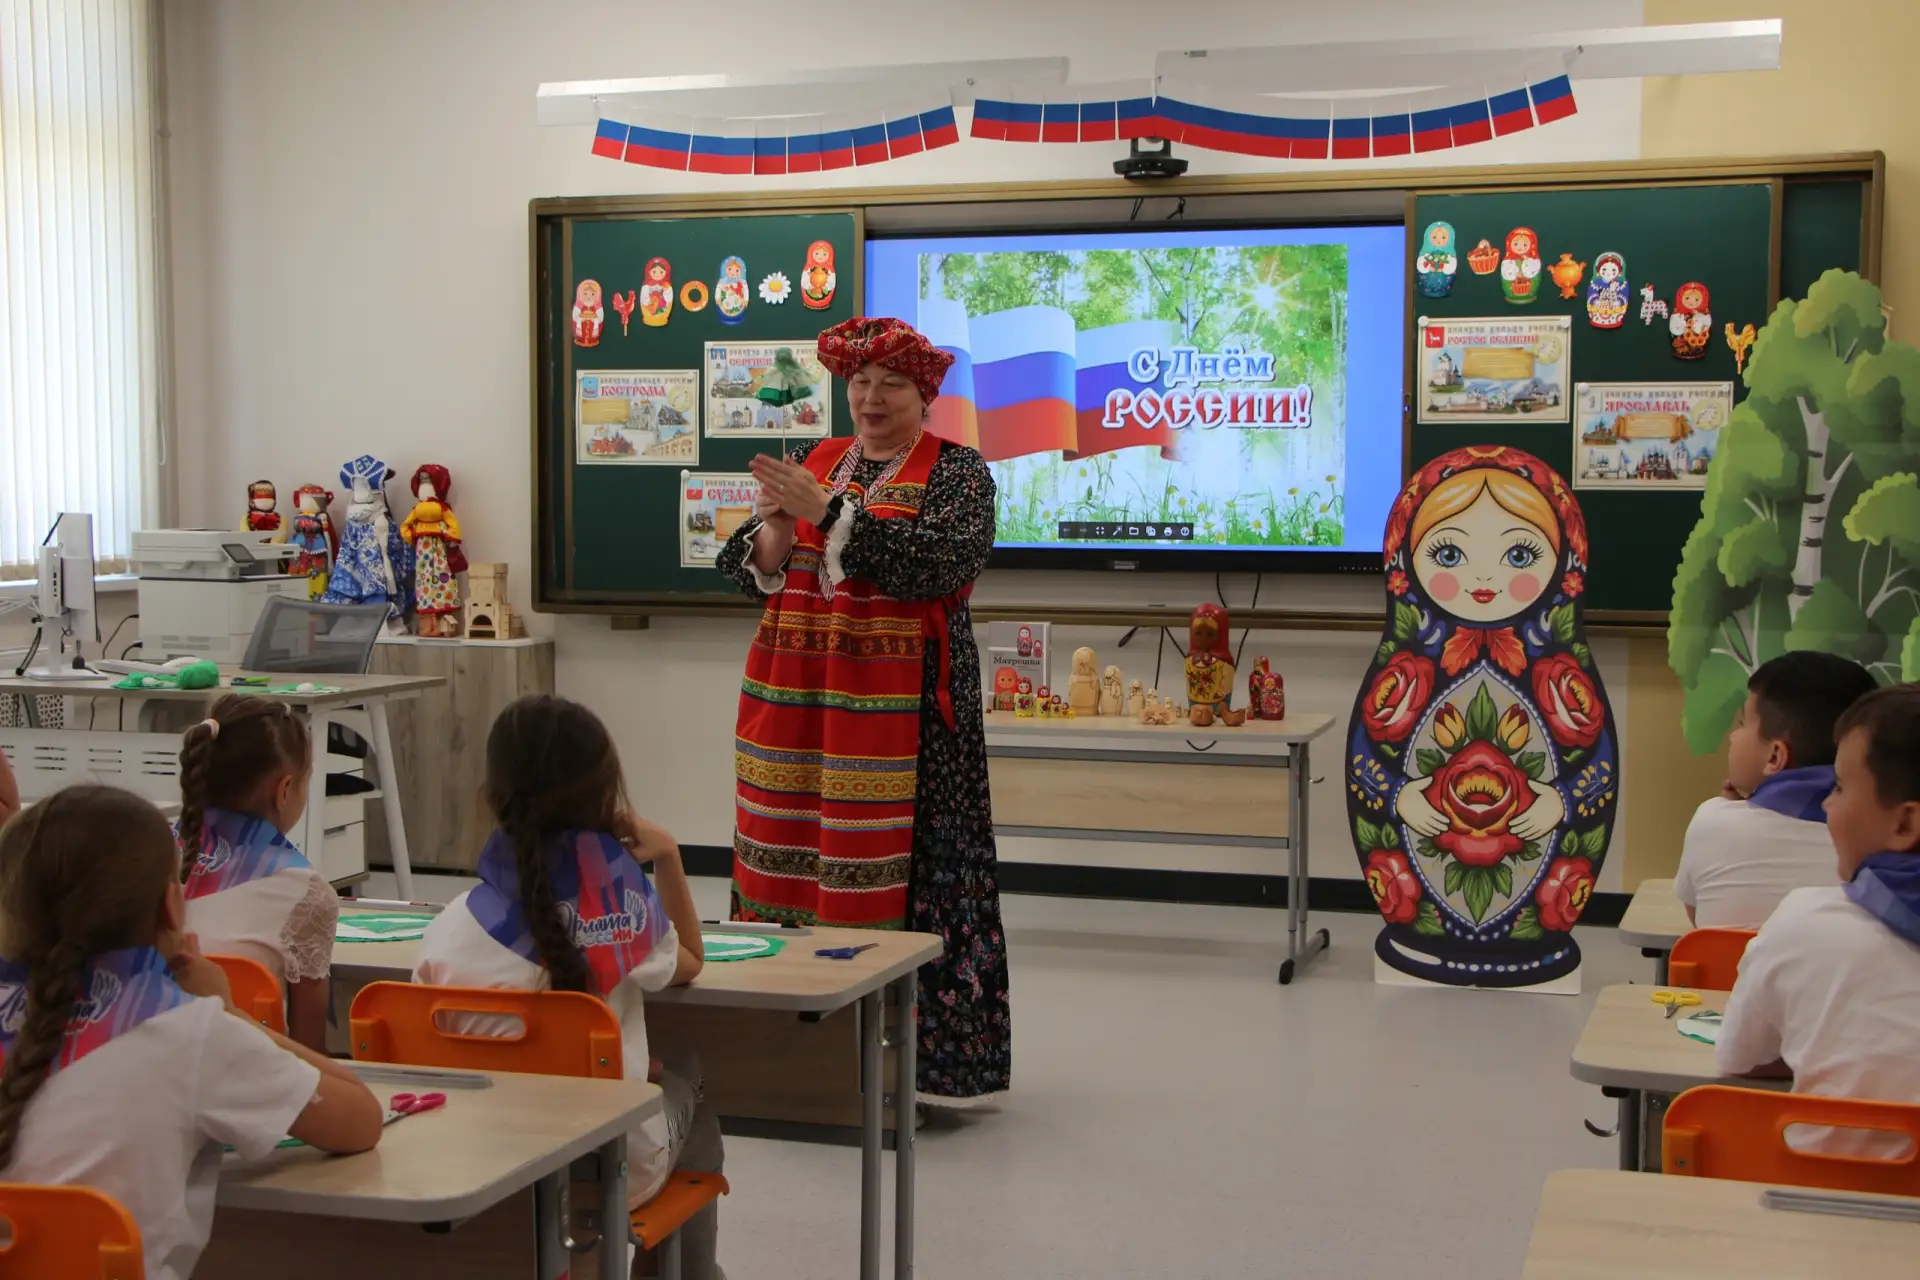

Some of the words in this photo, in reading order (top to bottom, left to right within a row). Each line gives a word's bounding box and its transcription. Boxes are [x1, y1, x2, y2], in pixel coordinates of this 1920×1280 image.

[1447, 336, 1486, 345] РОСТОВ
[1129, 348, 1159, 381] С
[1165, 347, 1276, 386] Днём
[600, 385, 666, 397] КОСТРОМА
[1102, 387, 1313, 427] РОССИИ!
[1605, 401, 1690, 412] ЯРОСЛАВЛЬ
